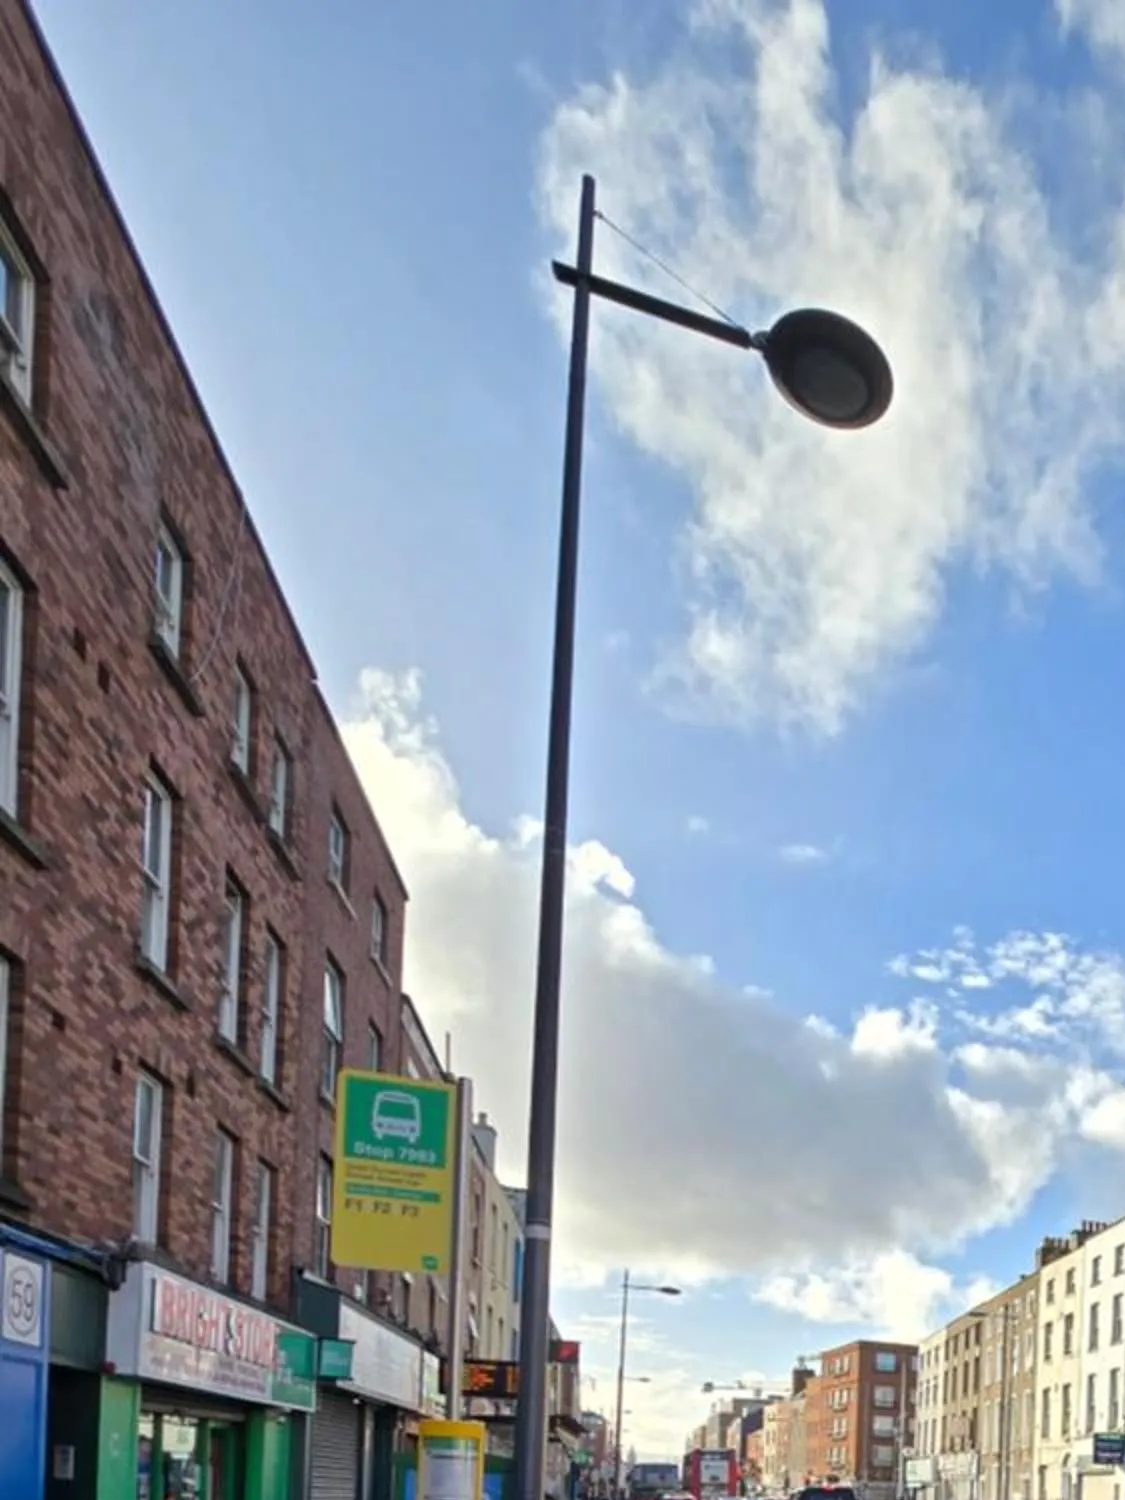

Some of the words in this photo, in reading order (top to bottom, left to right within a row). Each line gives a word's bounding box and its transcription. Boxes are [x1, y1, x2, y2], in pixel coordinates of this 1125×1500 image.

[353, 1141, 395, 1160] Stop
[11, 1279, 35, 1322] 59
[160, 1277, 228, 1354] BRIGHT
